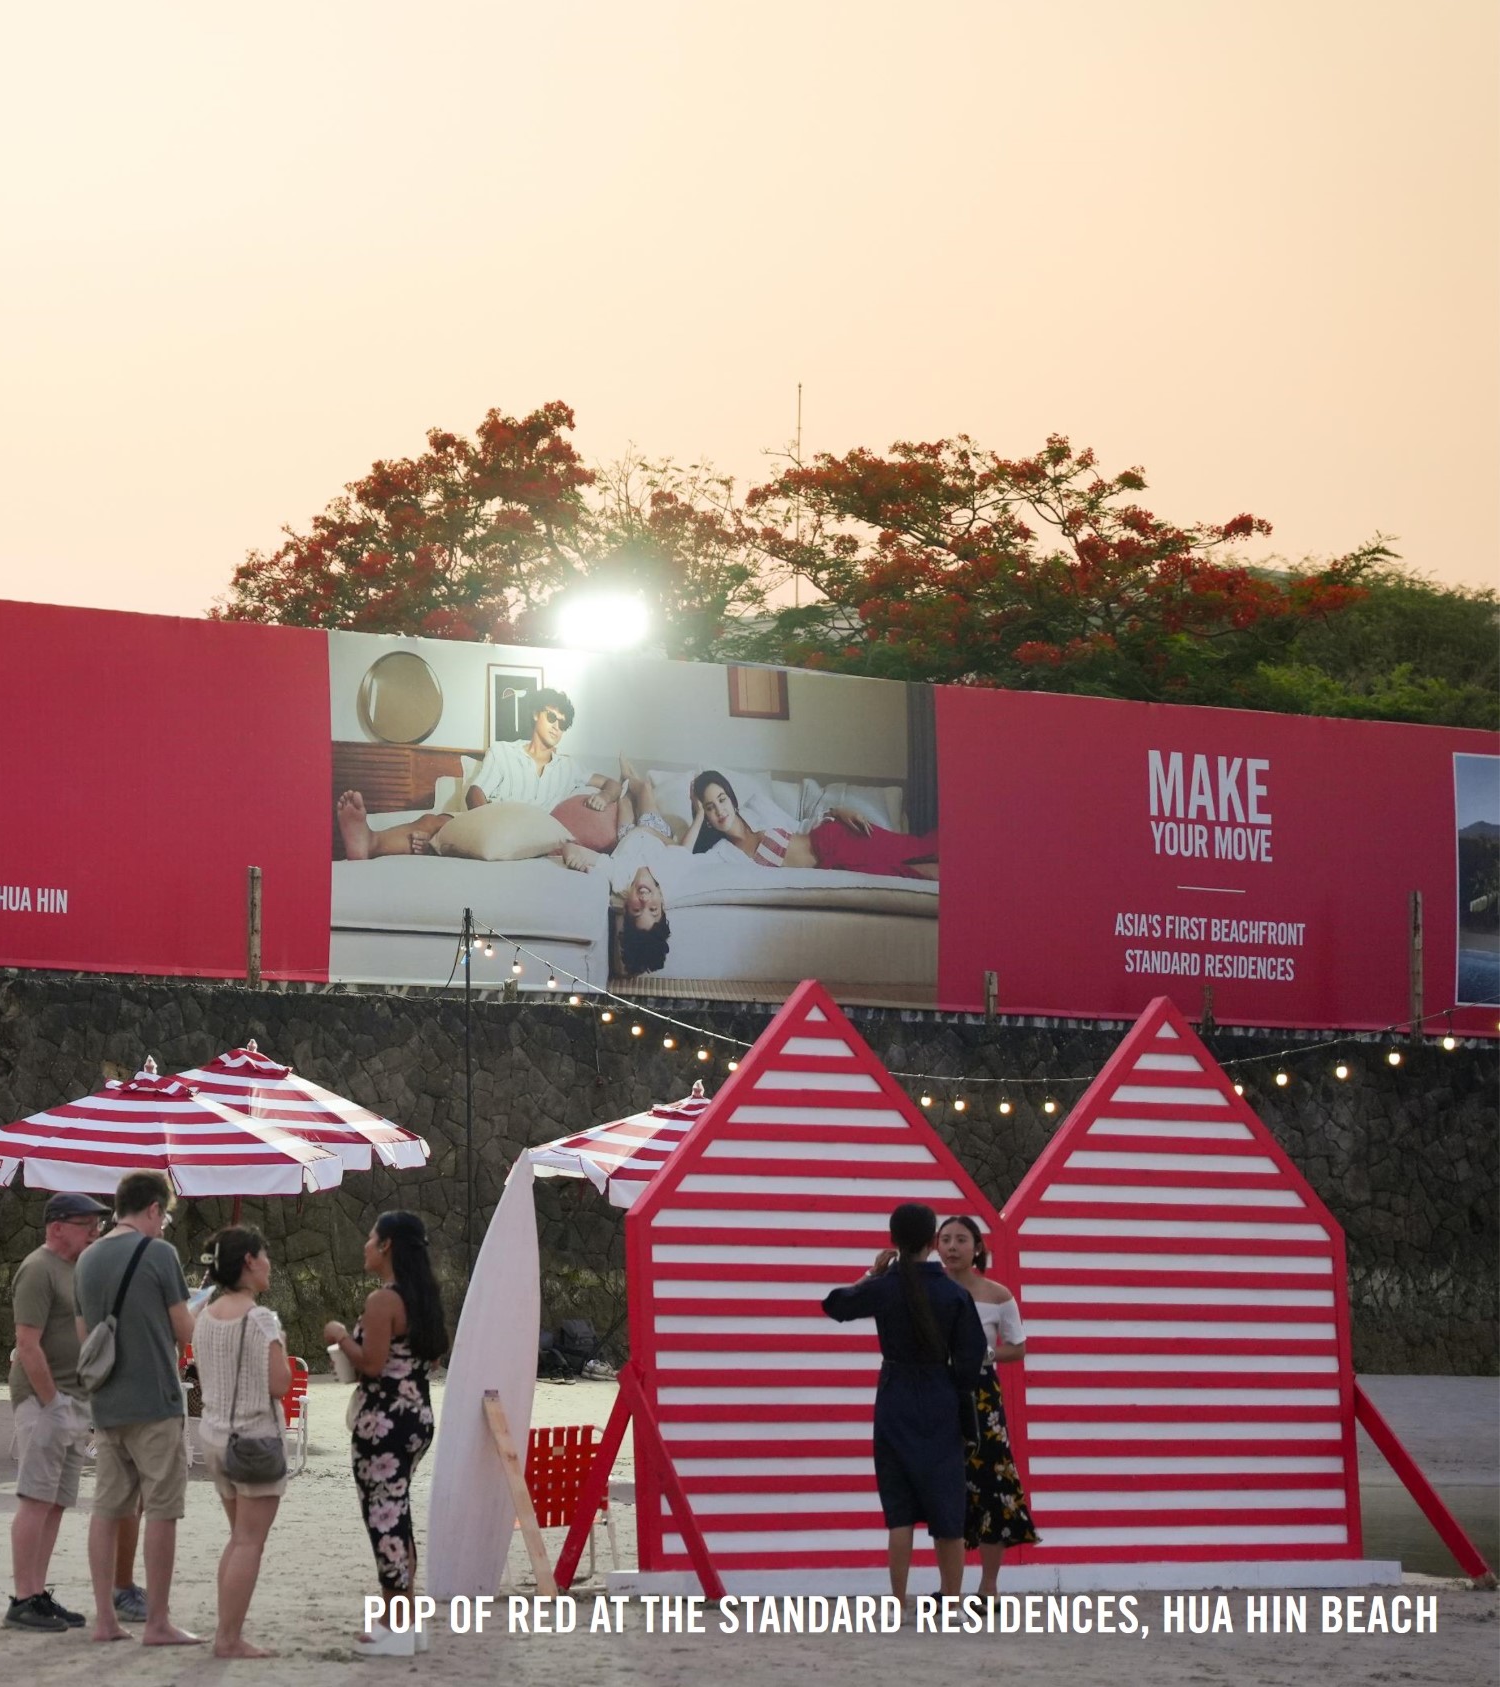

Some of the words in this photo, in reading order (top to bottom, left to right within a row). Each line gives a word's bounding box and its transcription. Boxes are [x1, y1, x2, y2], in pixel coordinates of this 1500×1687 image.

[1148, 749, 1272, 824] MAKE
[1150, 820, 1208, 858] YOUR
[1214, 826, 1273, 862] MOVE
[37, 888, 68, 914] HIN
[1115, 912, 1162, 938] ASIA'S
[1165, 915, 1207, 941] FIRST
[1211, 919, 1306, 946] BEACHFRONT
[1125, 949, 1200, 976] STANDARD
[1204, 954, 1295, 981] RESIDENCES
